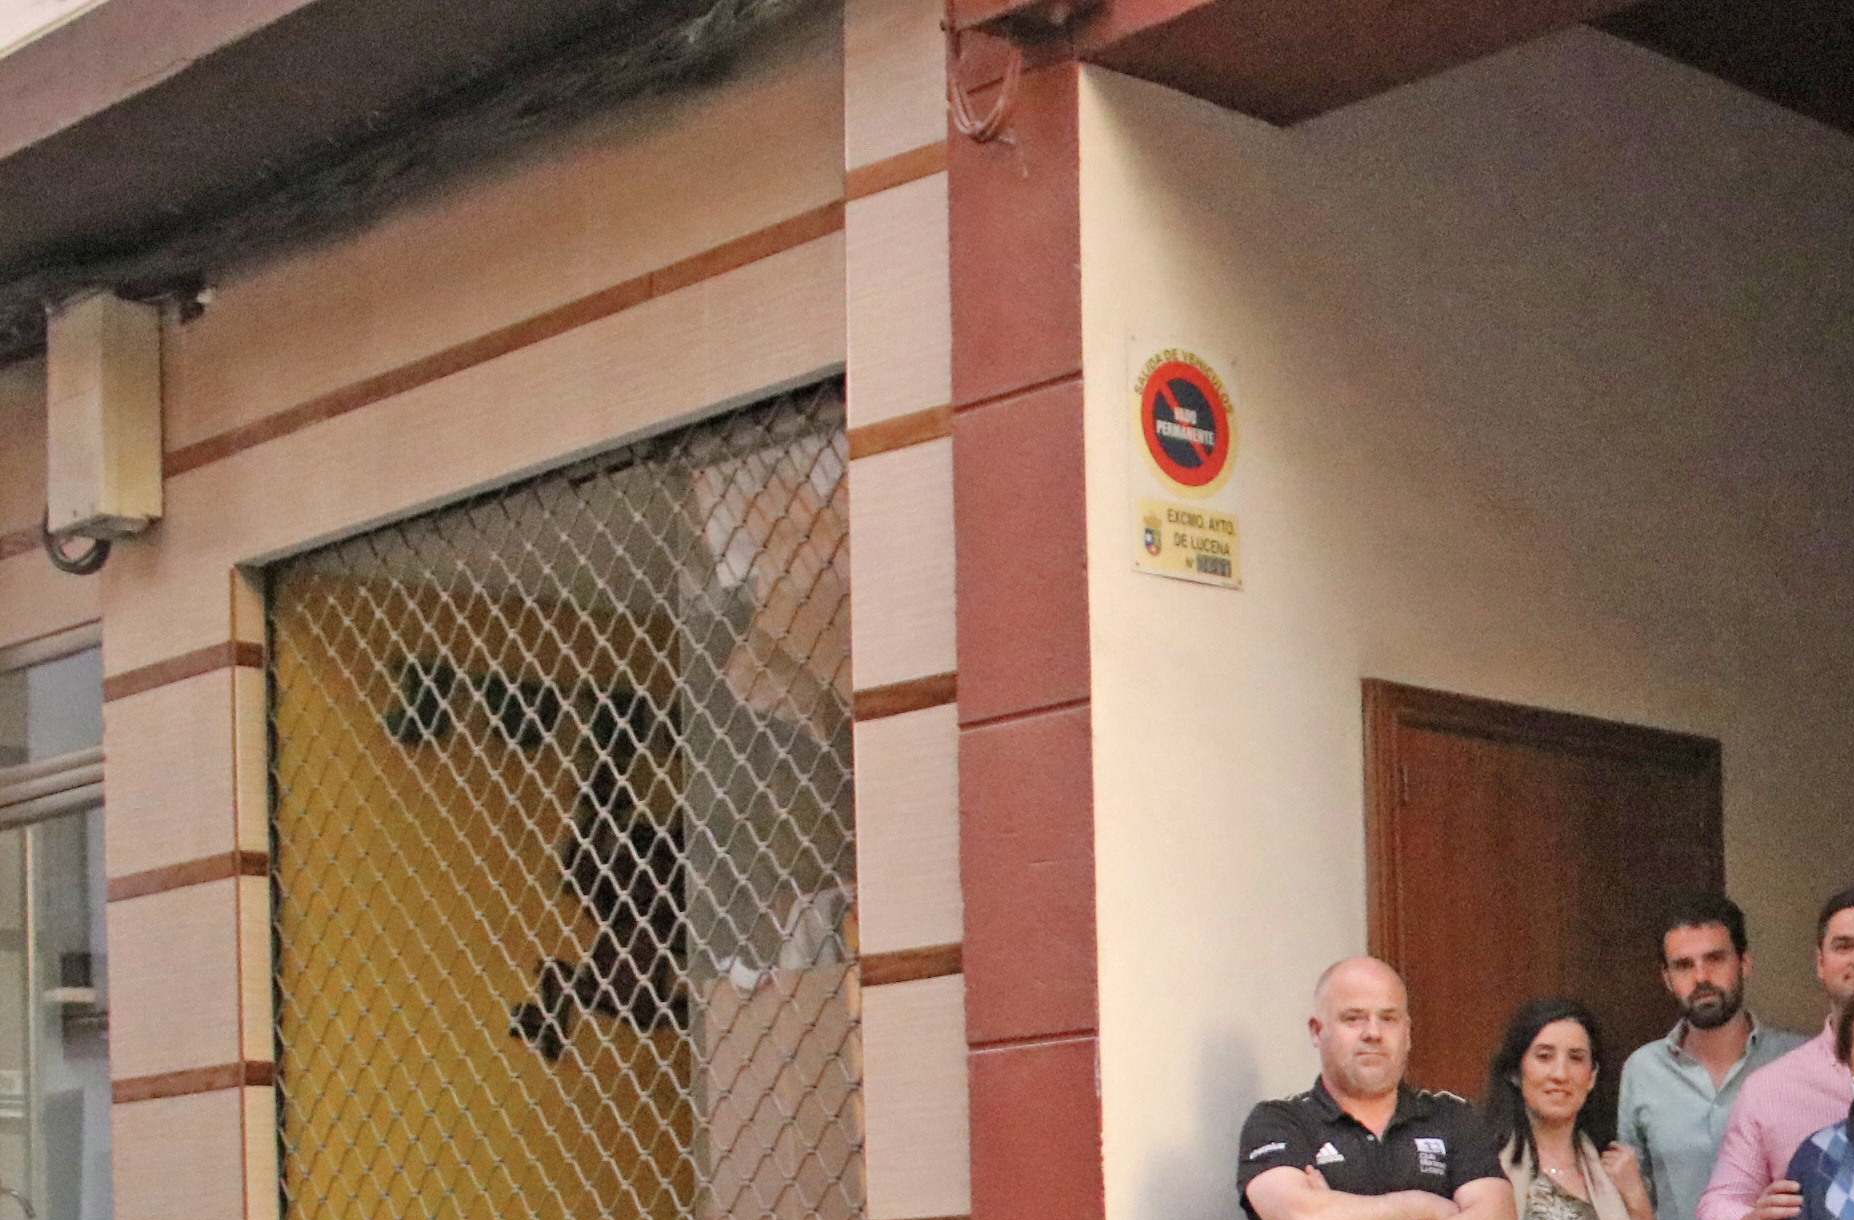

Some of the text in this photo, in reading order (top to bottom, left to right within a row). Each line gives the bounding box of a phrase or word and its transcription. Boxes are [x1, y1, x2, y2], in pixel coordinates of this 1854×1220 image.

[1164, 348, 1178, 361] DE
[1156, 419, 1215, 445] PERMANENTE
[1174, 532, 1230, 554] DE LUCENA
